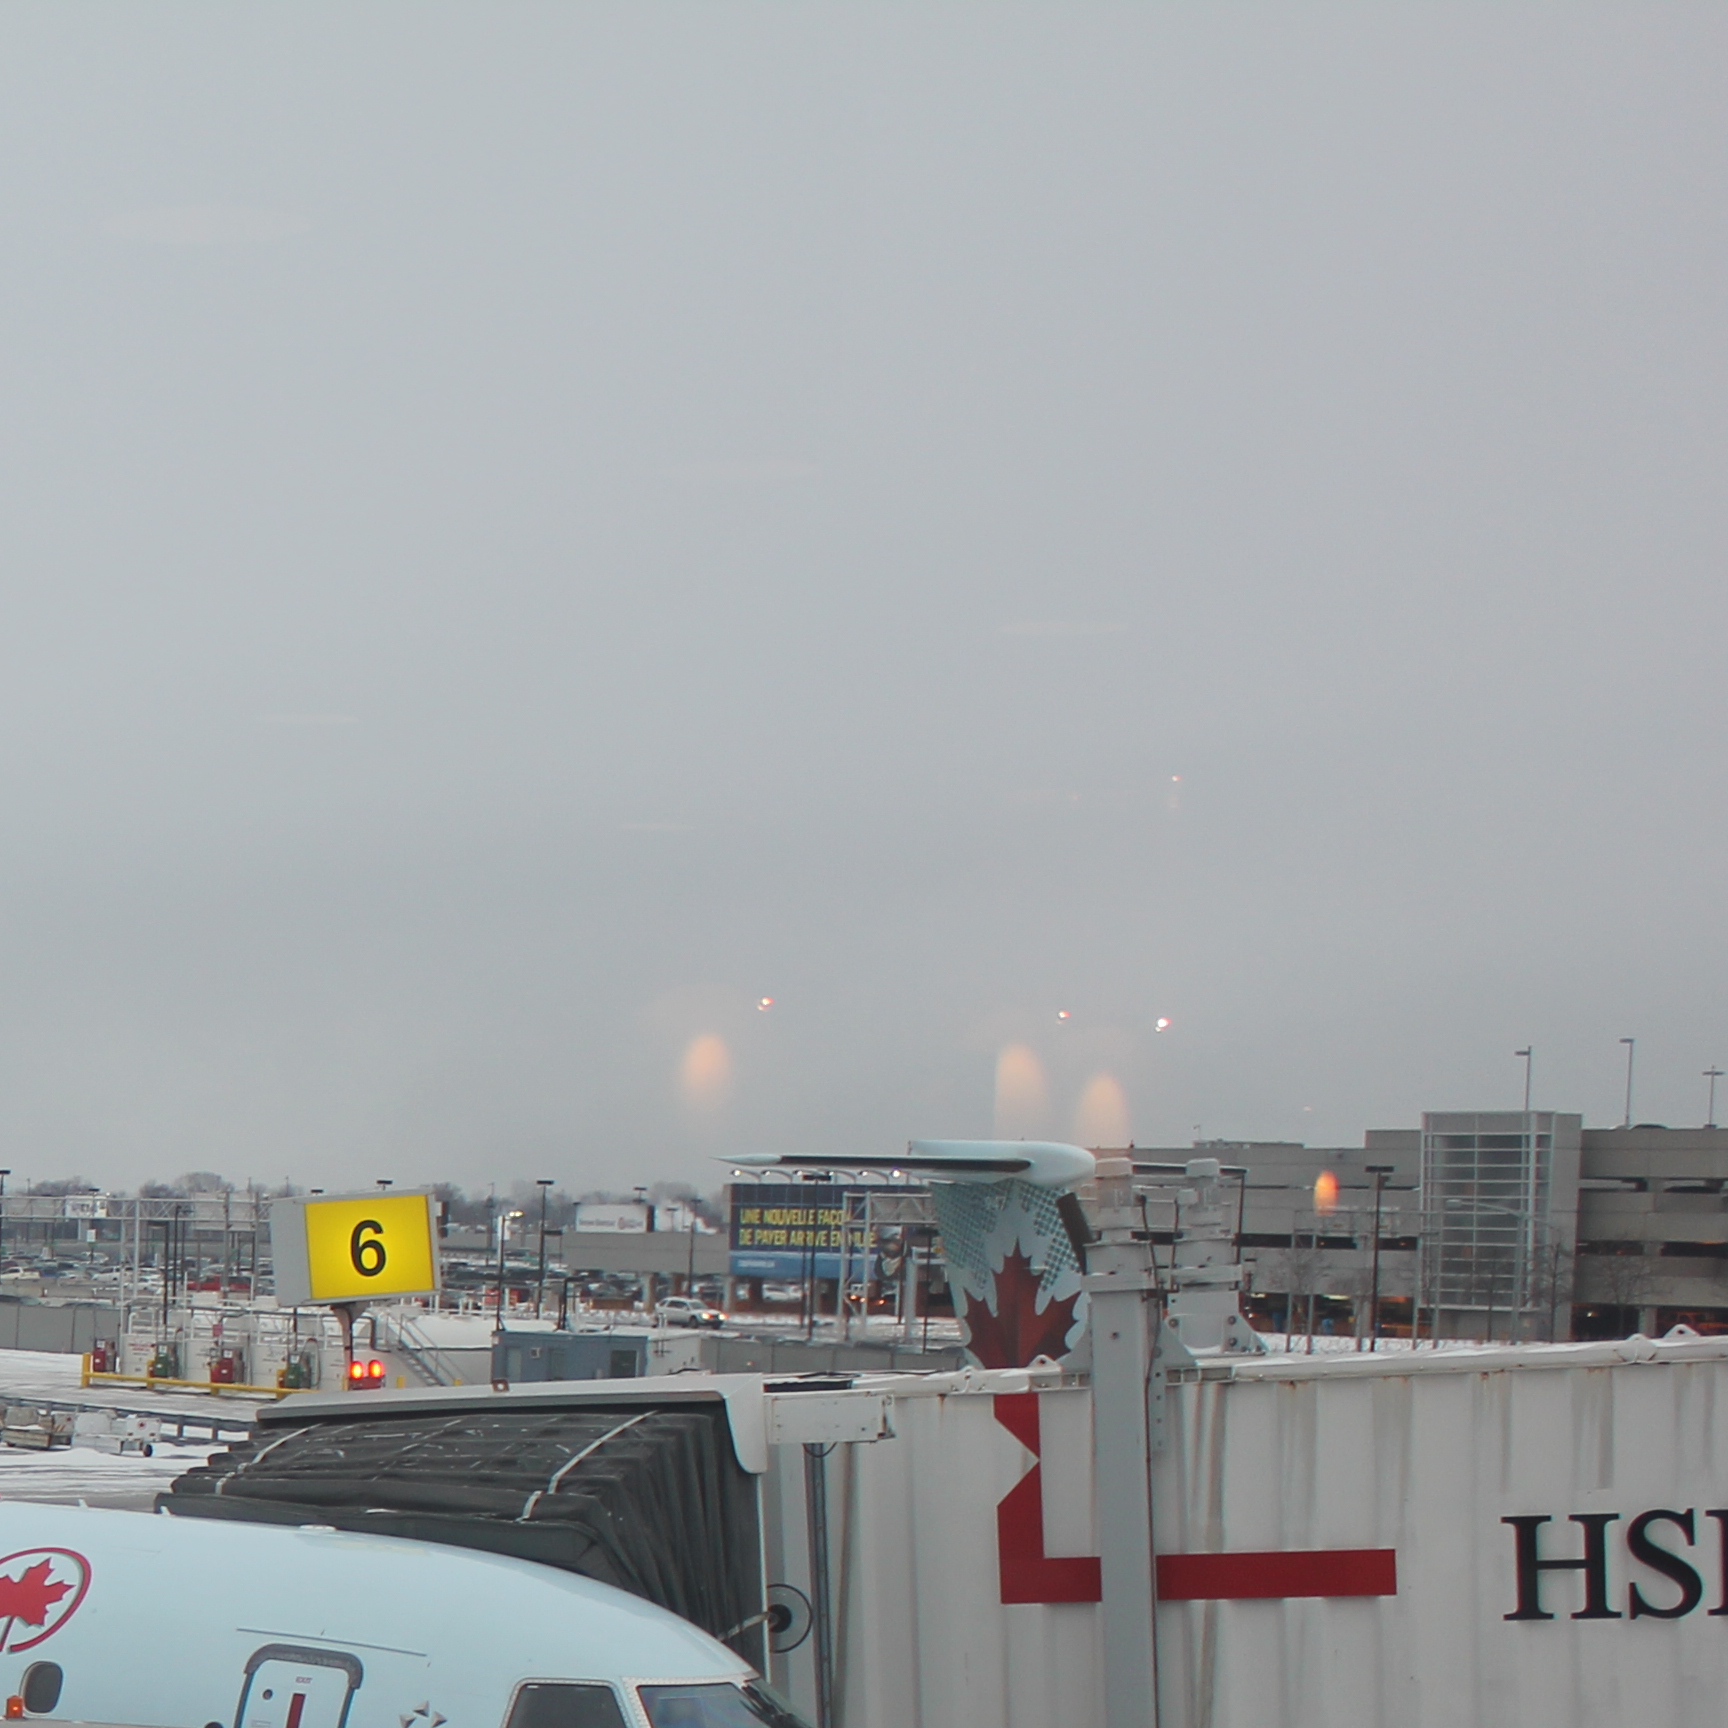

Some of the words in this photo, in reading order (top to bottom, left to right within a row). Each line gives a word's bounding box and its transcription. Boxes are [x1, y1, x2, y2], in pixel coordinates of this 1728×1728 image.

[739, 1208, 761, 1224] UNE
[763, 1208, 816, 1225] NOUVELLE
[738, 1228, 753, 1245] DE
[754, 1229, 787, 1246] PAYER
[350, 1219, 387, 1277] 6
